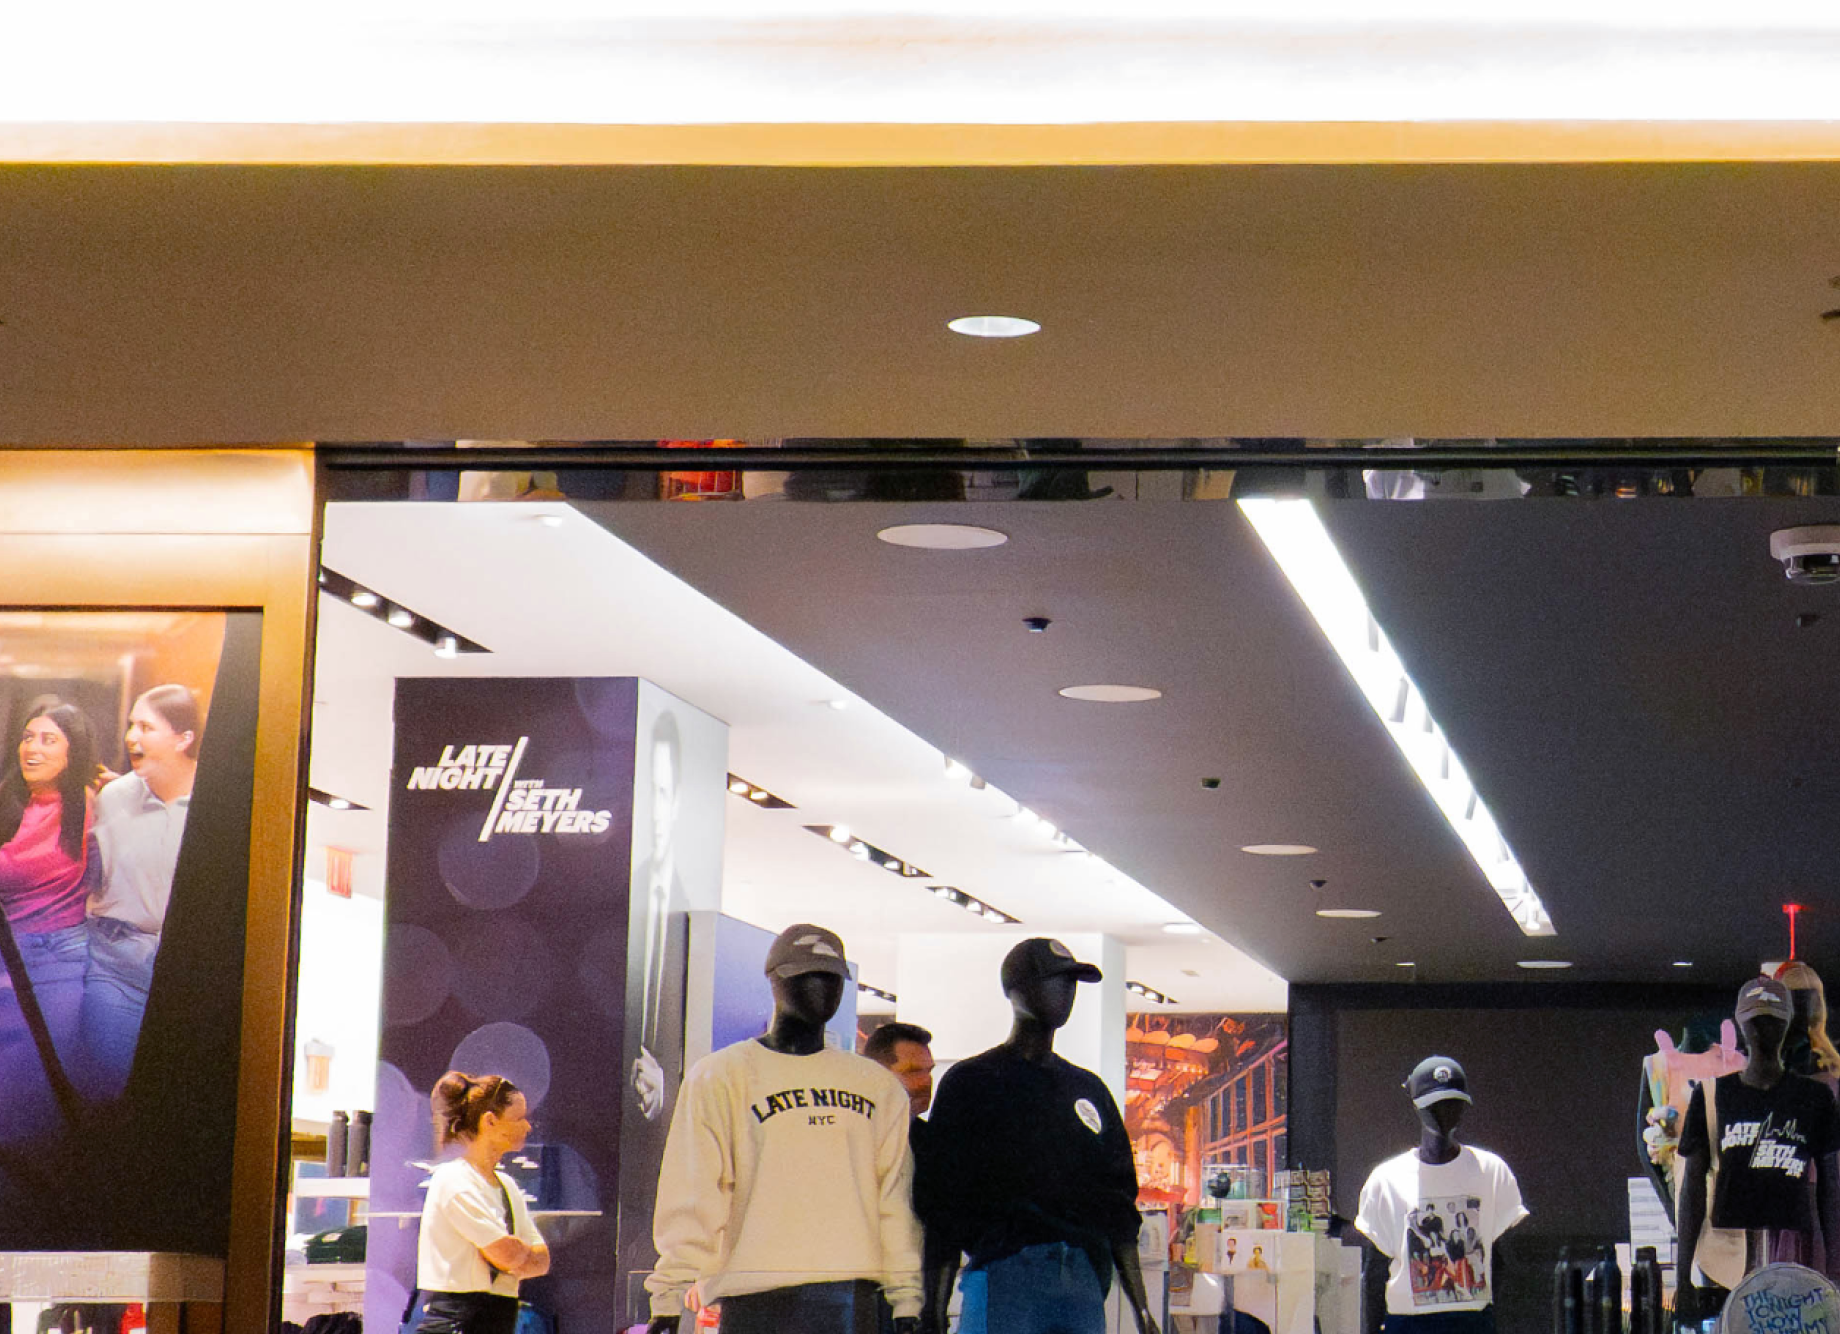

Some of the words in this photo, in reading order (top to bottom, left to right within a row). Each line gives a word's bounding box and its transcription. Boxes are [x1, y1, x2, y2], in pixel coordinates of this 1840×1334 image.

[437, 745, 513, 767] LATE
[407, 767, 504, 789] NIGHT
[505, 788, 583, 811] SETH
[495, 810, 612, 833] MEYERS
[751, 1088, 809, 1124] LATE
[809, 1088, 876, 1120] NIGHT
[808, 1115, 836, 1126] NYC
[1725, 1121, 1761, 1136] LATE
[1745, 1287, 1823, 1324] TONIGHT
